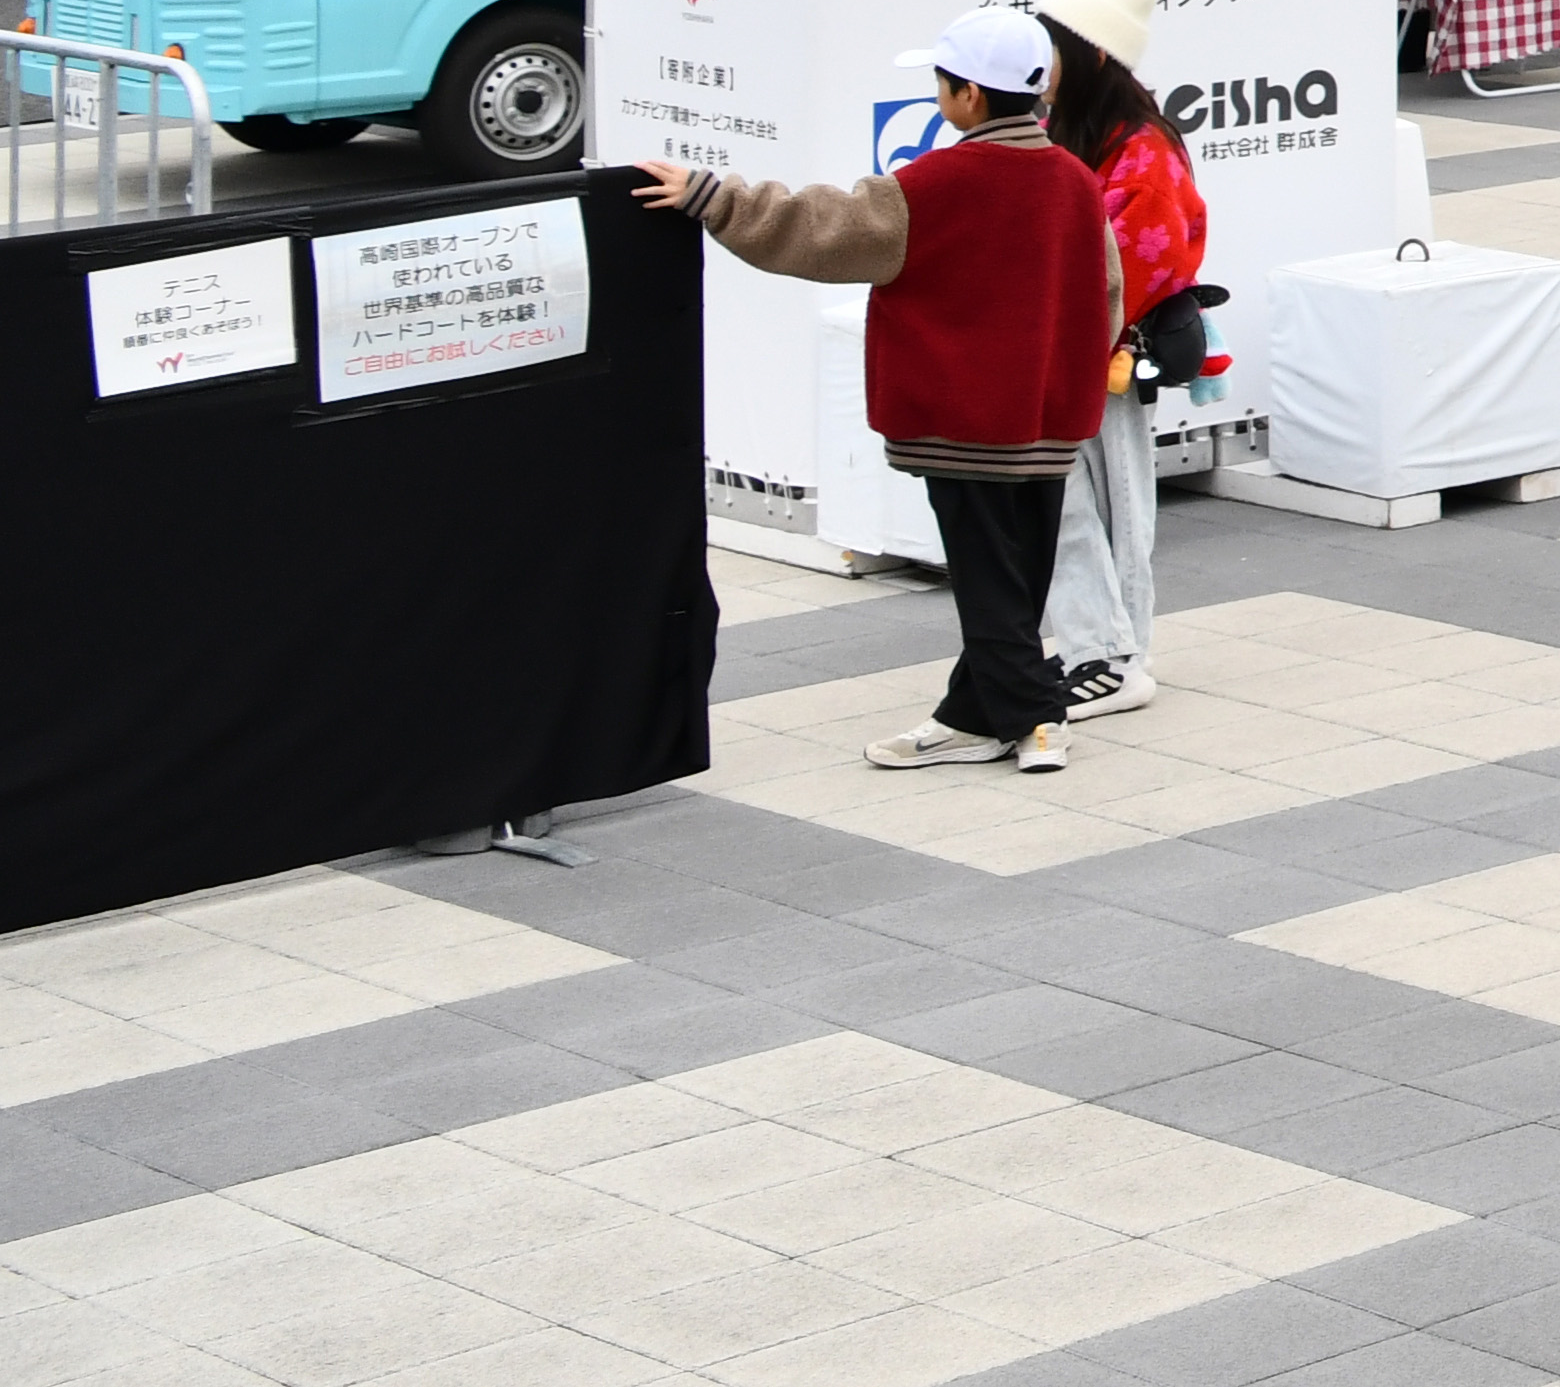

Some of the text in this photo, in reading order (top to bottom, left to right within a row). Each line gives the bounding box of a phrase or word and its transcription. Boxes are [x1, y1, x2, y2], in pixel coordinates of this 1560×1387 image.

[1161, 69, 1339, 134] eisha
[680, 140, 730, 167] 株式会社
[1201, 135, 1270, 162] 株式会社
[359, 222, 539, 267] 高崎国際オープンで
[163, 273, 221, 299] テニス
[392, 252, 513, 289] 使われている
[134, 297, 252, 328] 体験コーナー
[363, 275, 546, 321] 世界基準の高品質な
[352, 300, 550, 348] ハードコートを体験！
[344, 325, 566, 377] ご自由にお試しください
